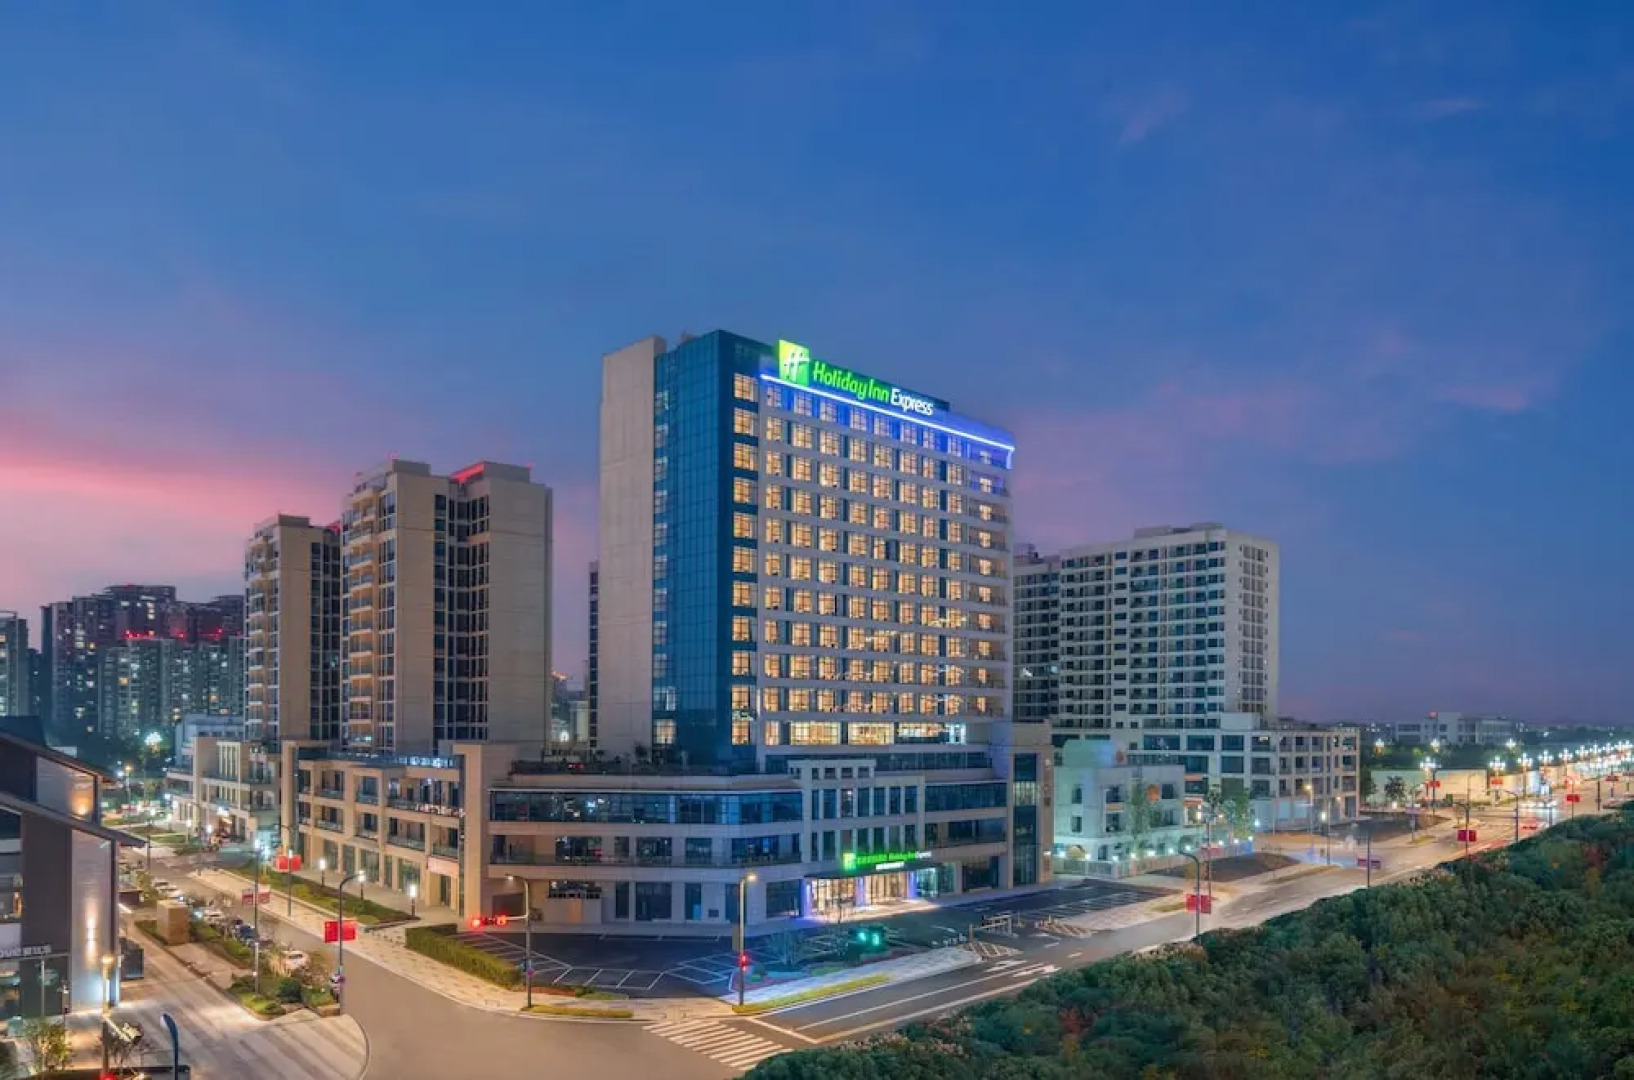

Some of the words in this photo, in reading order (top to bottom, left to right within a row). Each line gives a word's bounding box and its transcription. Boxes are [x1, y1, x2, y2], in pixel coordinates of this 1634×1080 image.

[813, 361, 868, 399] Holiday
[868, 378, 889, 402] Inn
[891, 387, 934, 415] Express
